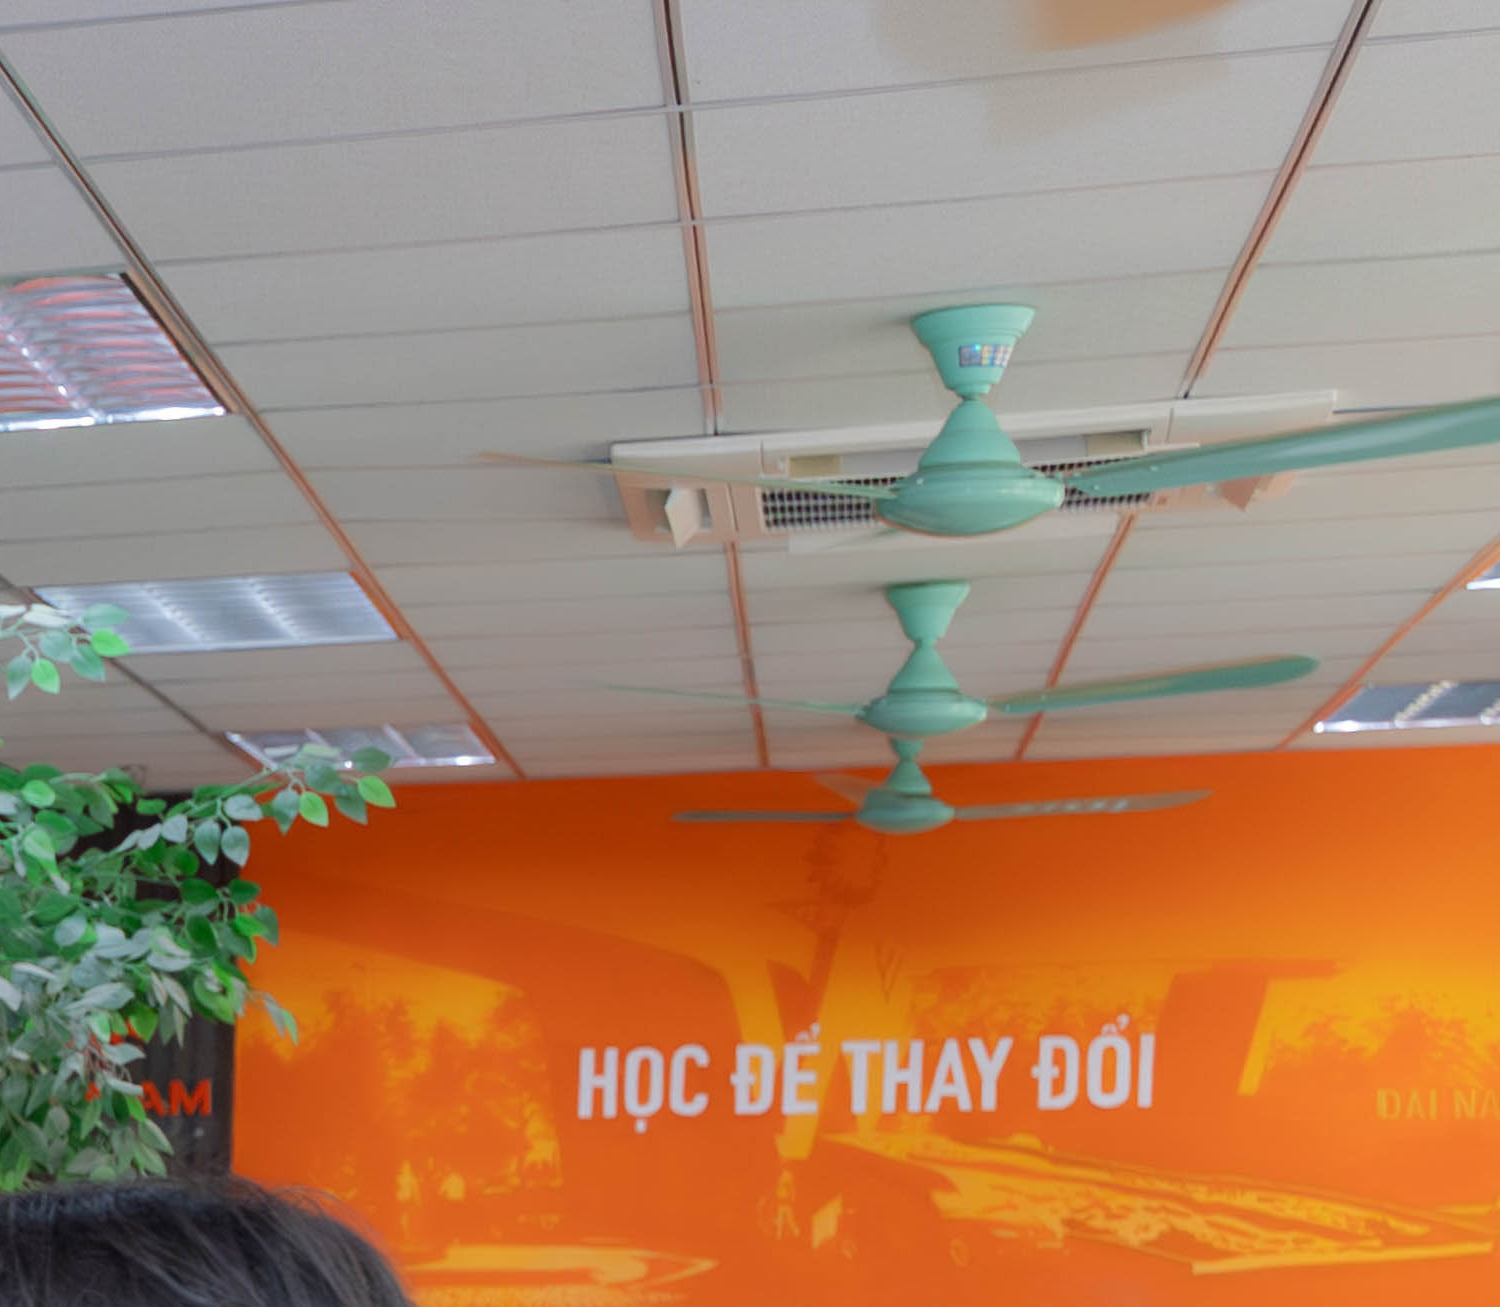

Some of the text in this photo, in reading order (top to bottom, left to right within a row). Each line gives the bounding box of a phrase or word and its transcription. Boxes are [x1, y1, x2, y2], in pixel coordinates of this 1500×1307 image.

[576, 1014, 1157, 1134] HỌC ĐỂ THAY ĐỔI
